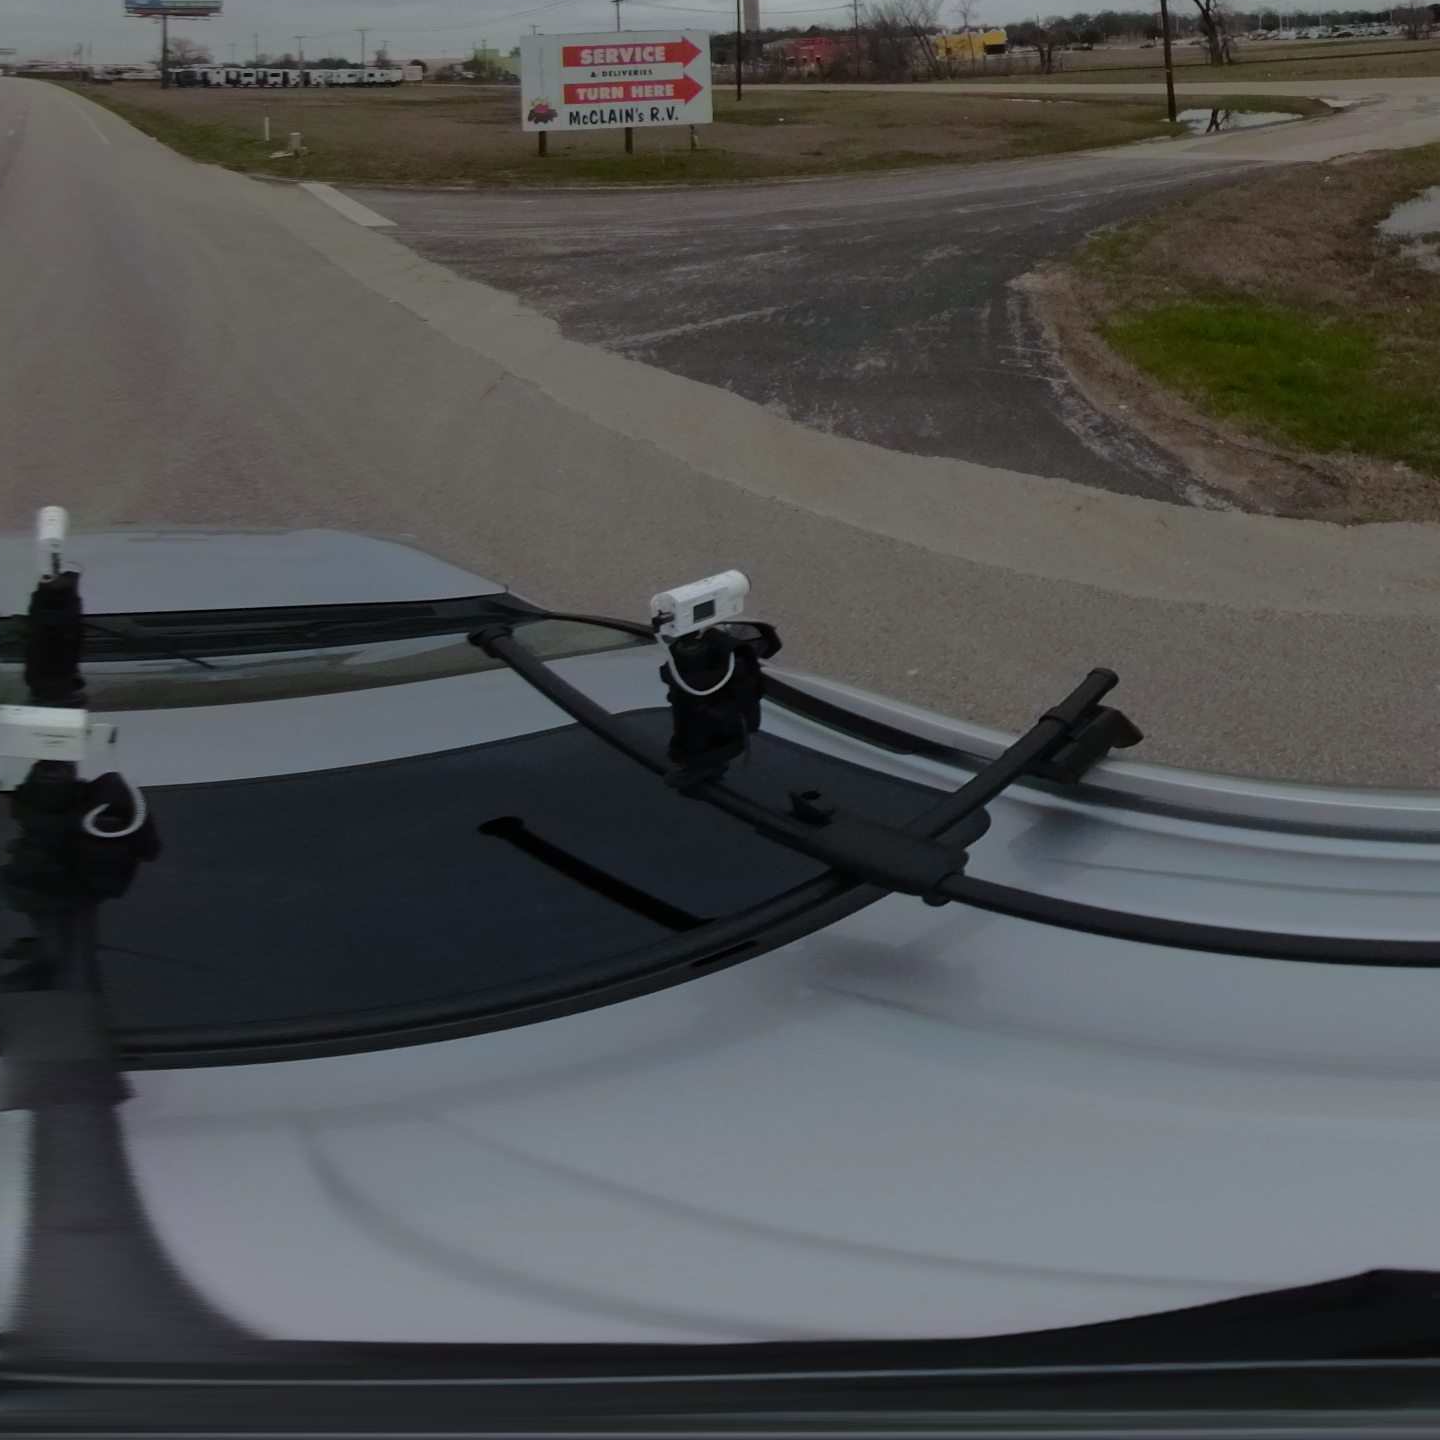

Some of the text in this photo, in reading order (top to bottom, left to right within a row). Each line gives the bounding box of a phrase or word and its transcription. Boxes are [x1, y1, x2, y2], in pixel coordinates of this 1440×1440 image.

[580, 46, 666, 65] SERVICE
[602, 69, 653, 77] DELIVERIES
[576, 84, 675, 101] TURN HERE
[569, 106, 679, 126] McCLAIN's R.V.
